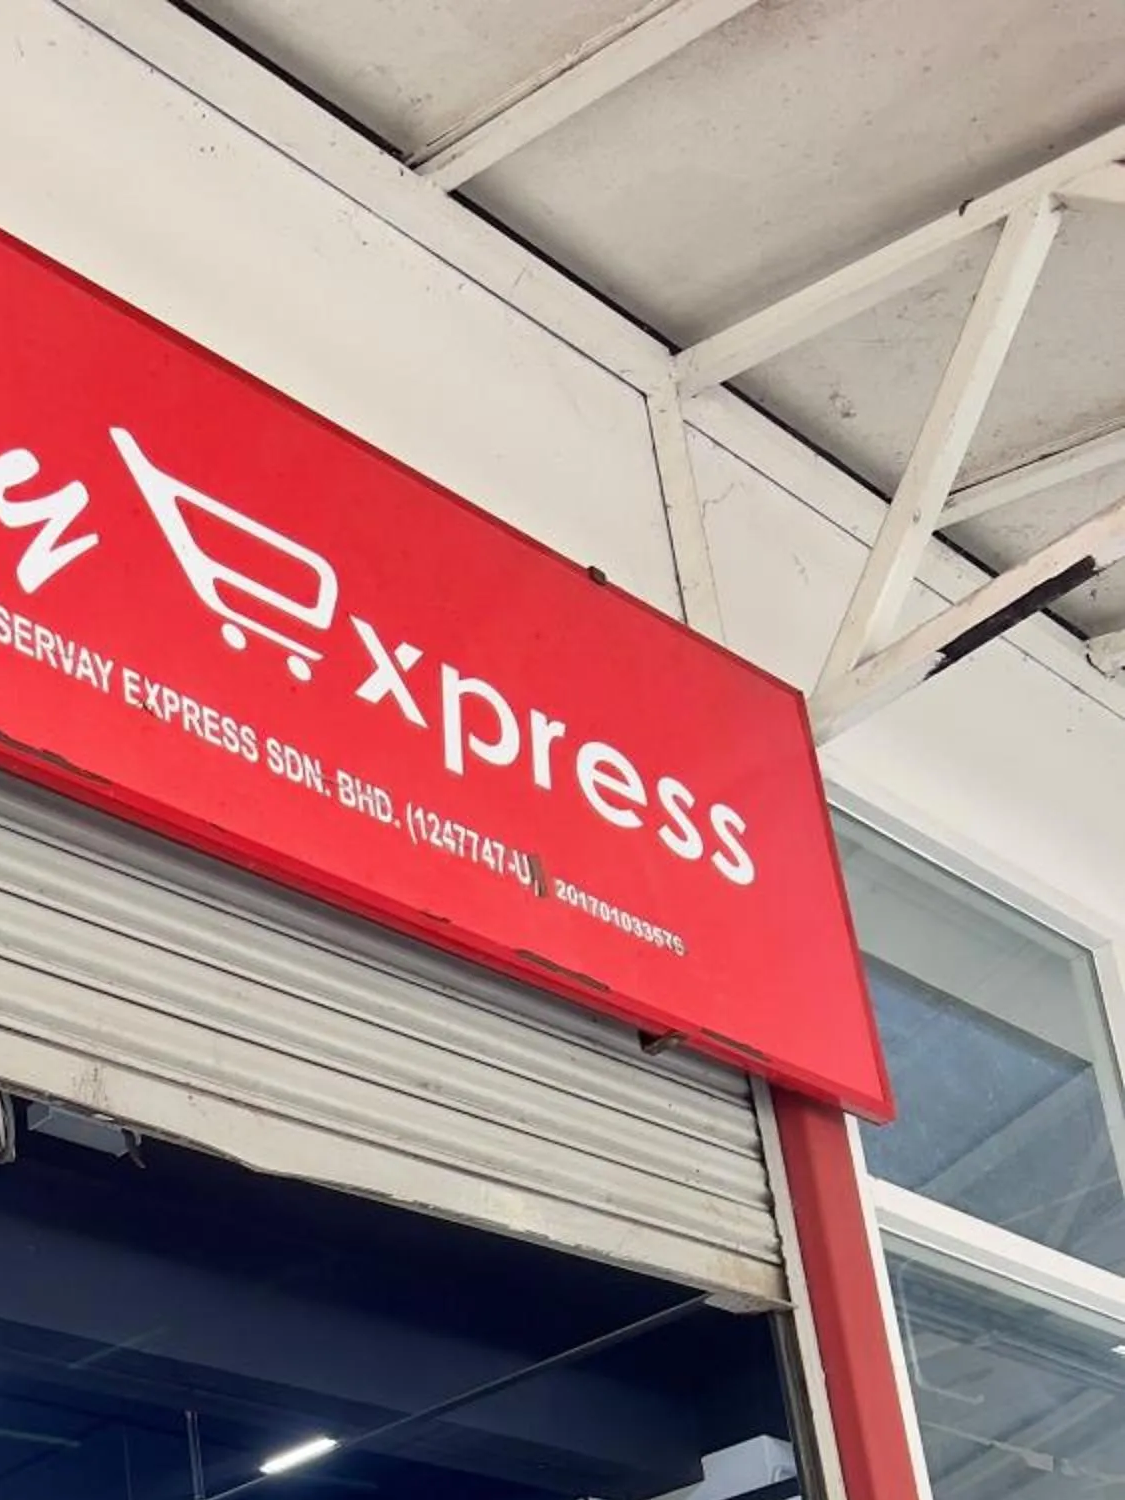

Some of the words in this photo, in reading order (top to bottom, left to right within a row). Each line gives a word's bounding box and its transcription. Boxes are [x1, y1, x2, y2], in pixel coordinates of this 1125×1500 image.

[123, 667, 259, 763] EXPRESS
[266, 738, 331, 797] SDN.
[336, 769, 401, 828] BHD.
